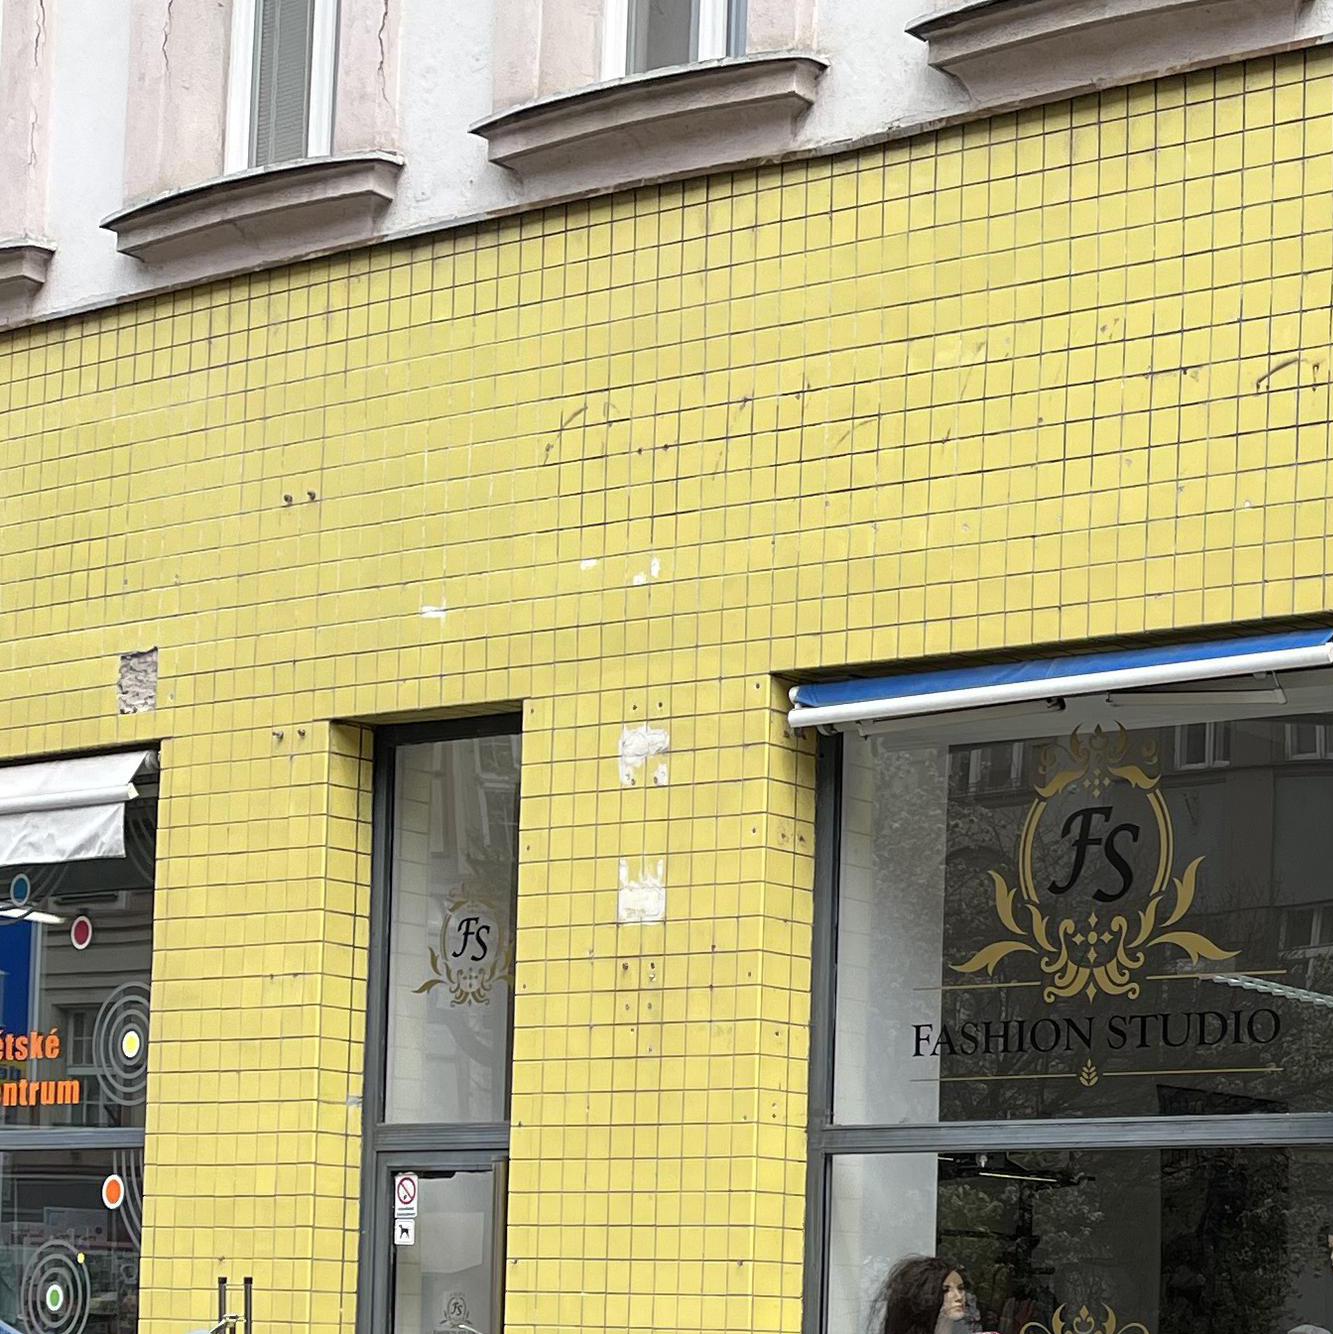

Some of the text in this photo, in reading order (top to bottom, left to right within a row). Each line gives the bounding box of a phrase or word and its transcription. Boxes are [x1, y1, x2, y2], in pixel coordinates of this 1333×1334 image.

[1047, 806, 1141, 903] FS
[0, 1027, 61, 1061] tské
[912, 1008, 1282, 1058] FASHION STUDIO
[0, 1078, 81, 1107] ntrum
